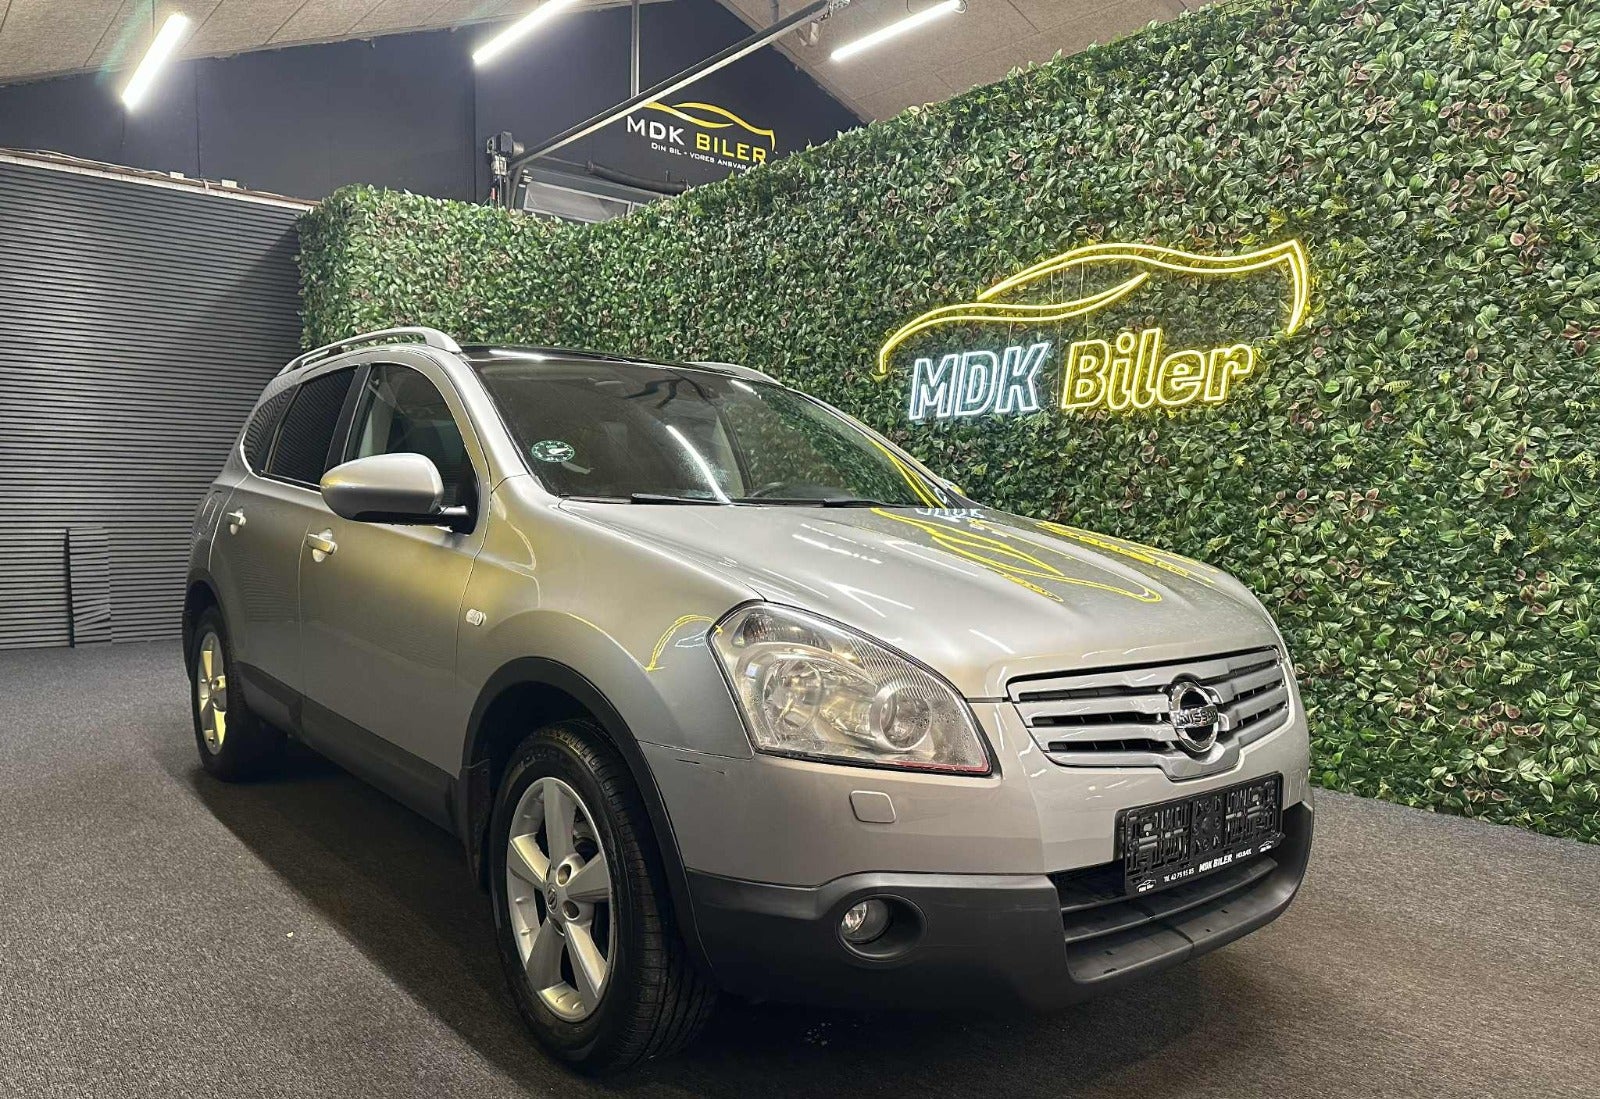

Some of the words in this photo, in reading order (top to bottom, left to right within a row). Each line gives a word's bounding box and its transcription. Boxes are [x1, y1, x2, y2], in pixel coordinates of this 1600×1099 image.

[626, 115, 685, 145] MDK
[696, 132, 767, 164] BILER
[669, 147, 682, 156] BIL
[908, 342, 1051, 420] MDK
[1061, 327, 1255, 411] Biler
[1213, 853, 1233, 868] BILER
